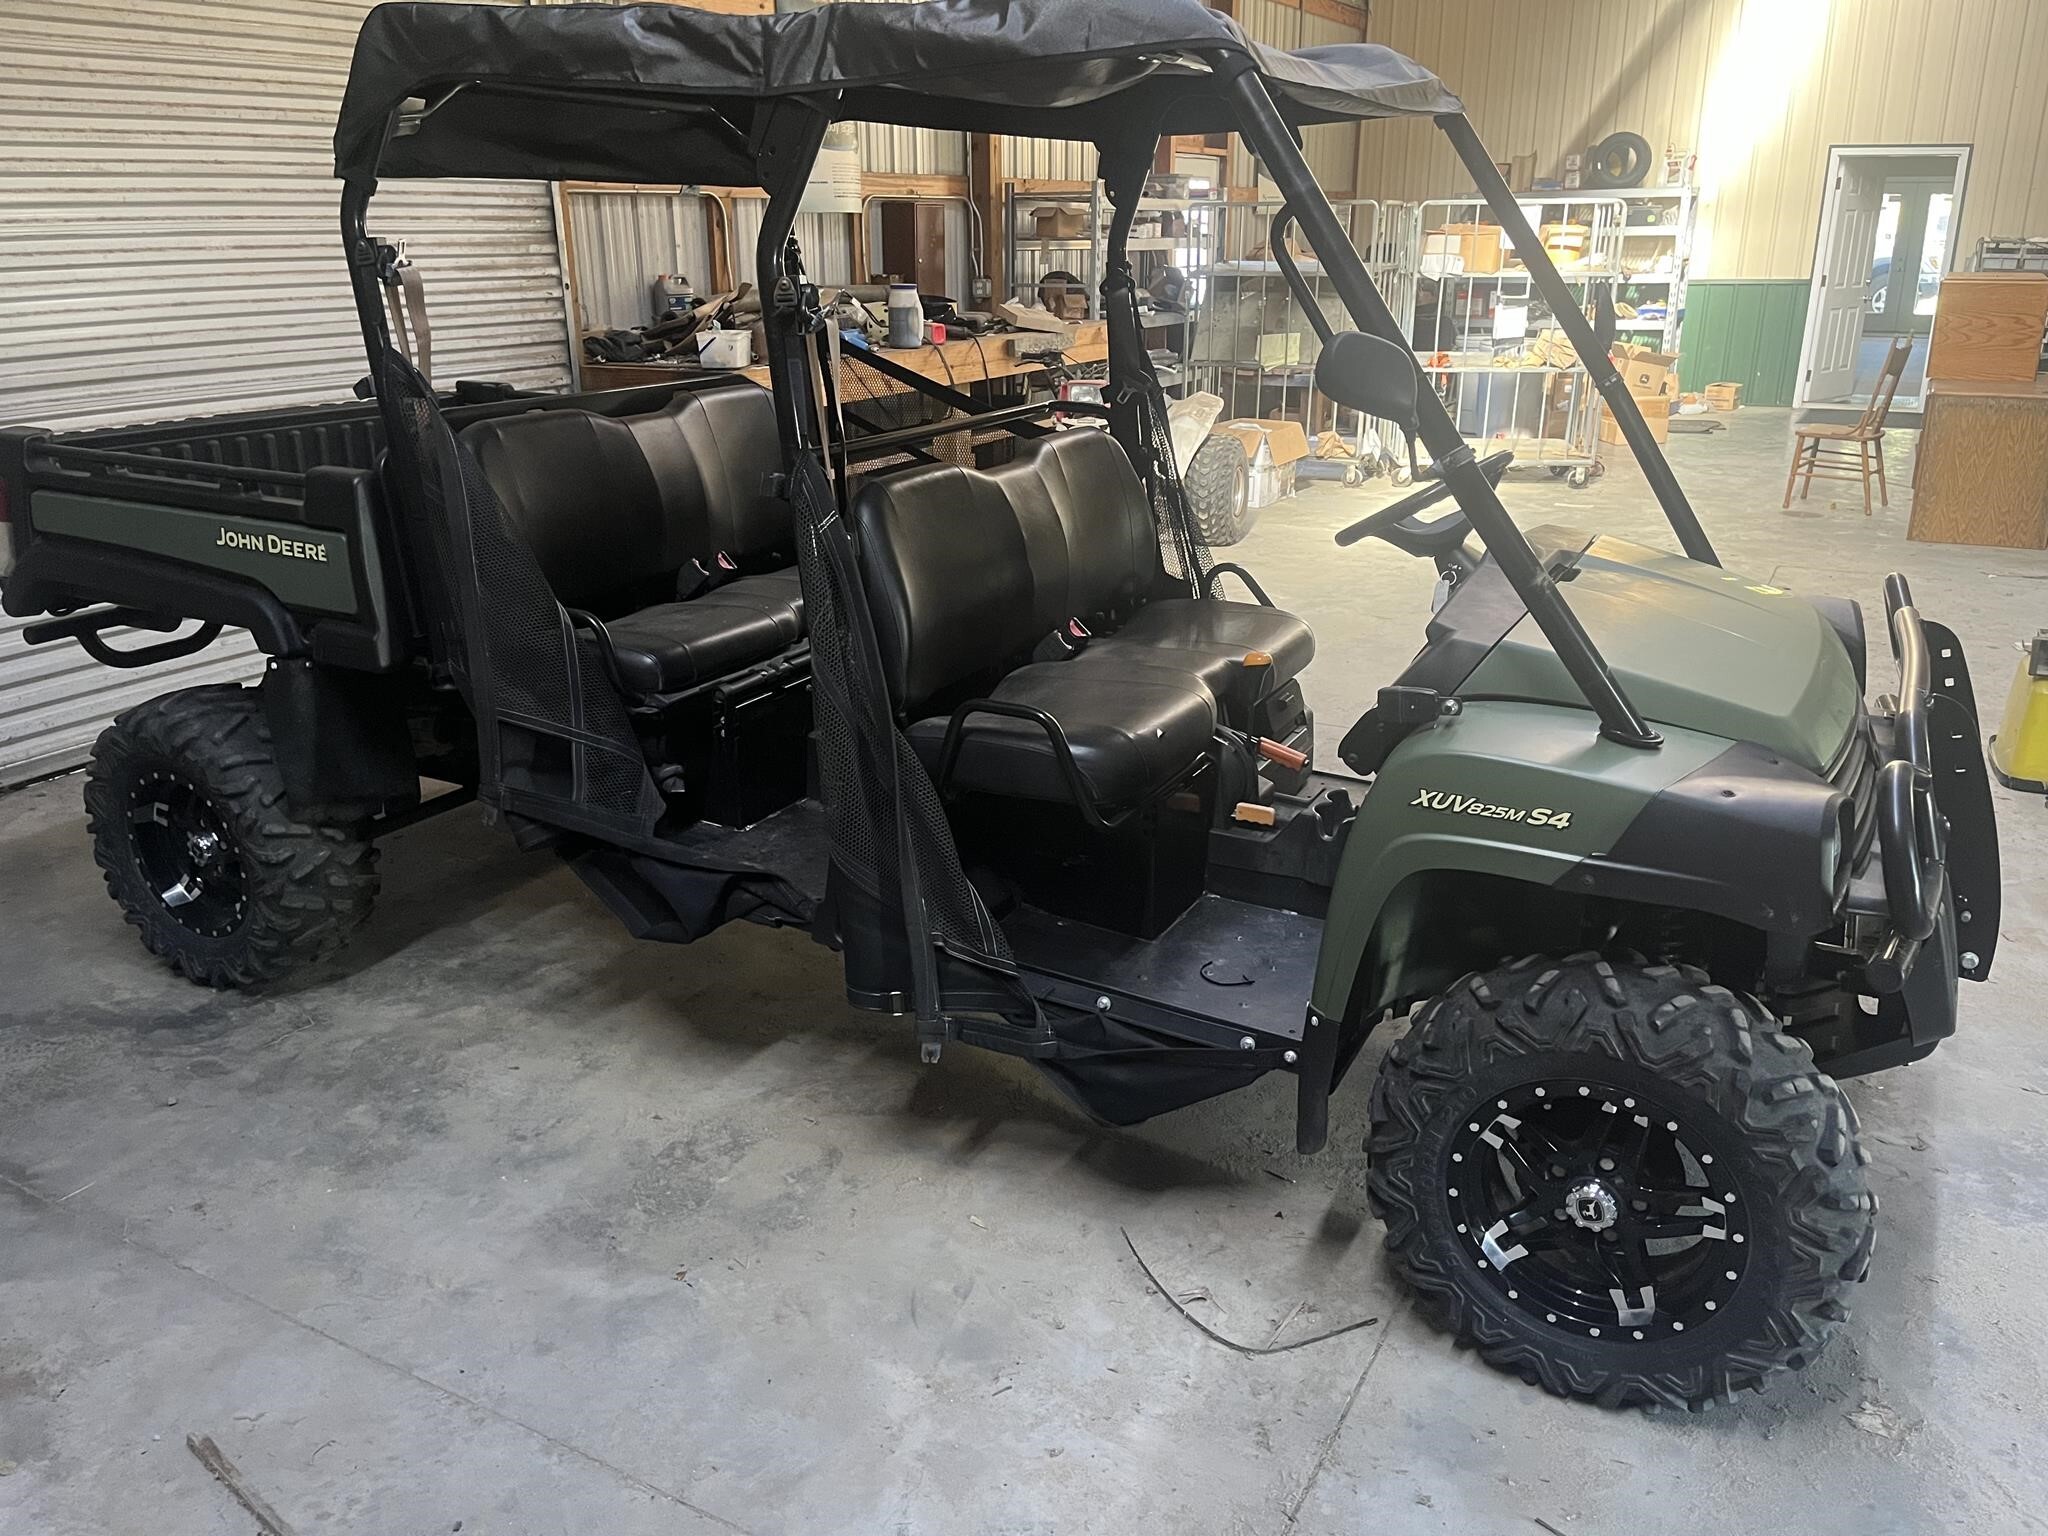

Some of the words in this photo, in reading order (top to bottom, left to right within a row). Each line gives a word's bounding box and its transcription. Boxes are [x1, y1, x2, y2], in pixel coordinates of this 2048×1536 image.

[216, 527, 264, 552] JOHN
[267, 534, 328, 562] DEERE
[1410, 788, 1526, 823] XUV825M
[1526, 807, 1573, 830] S4
